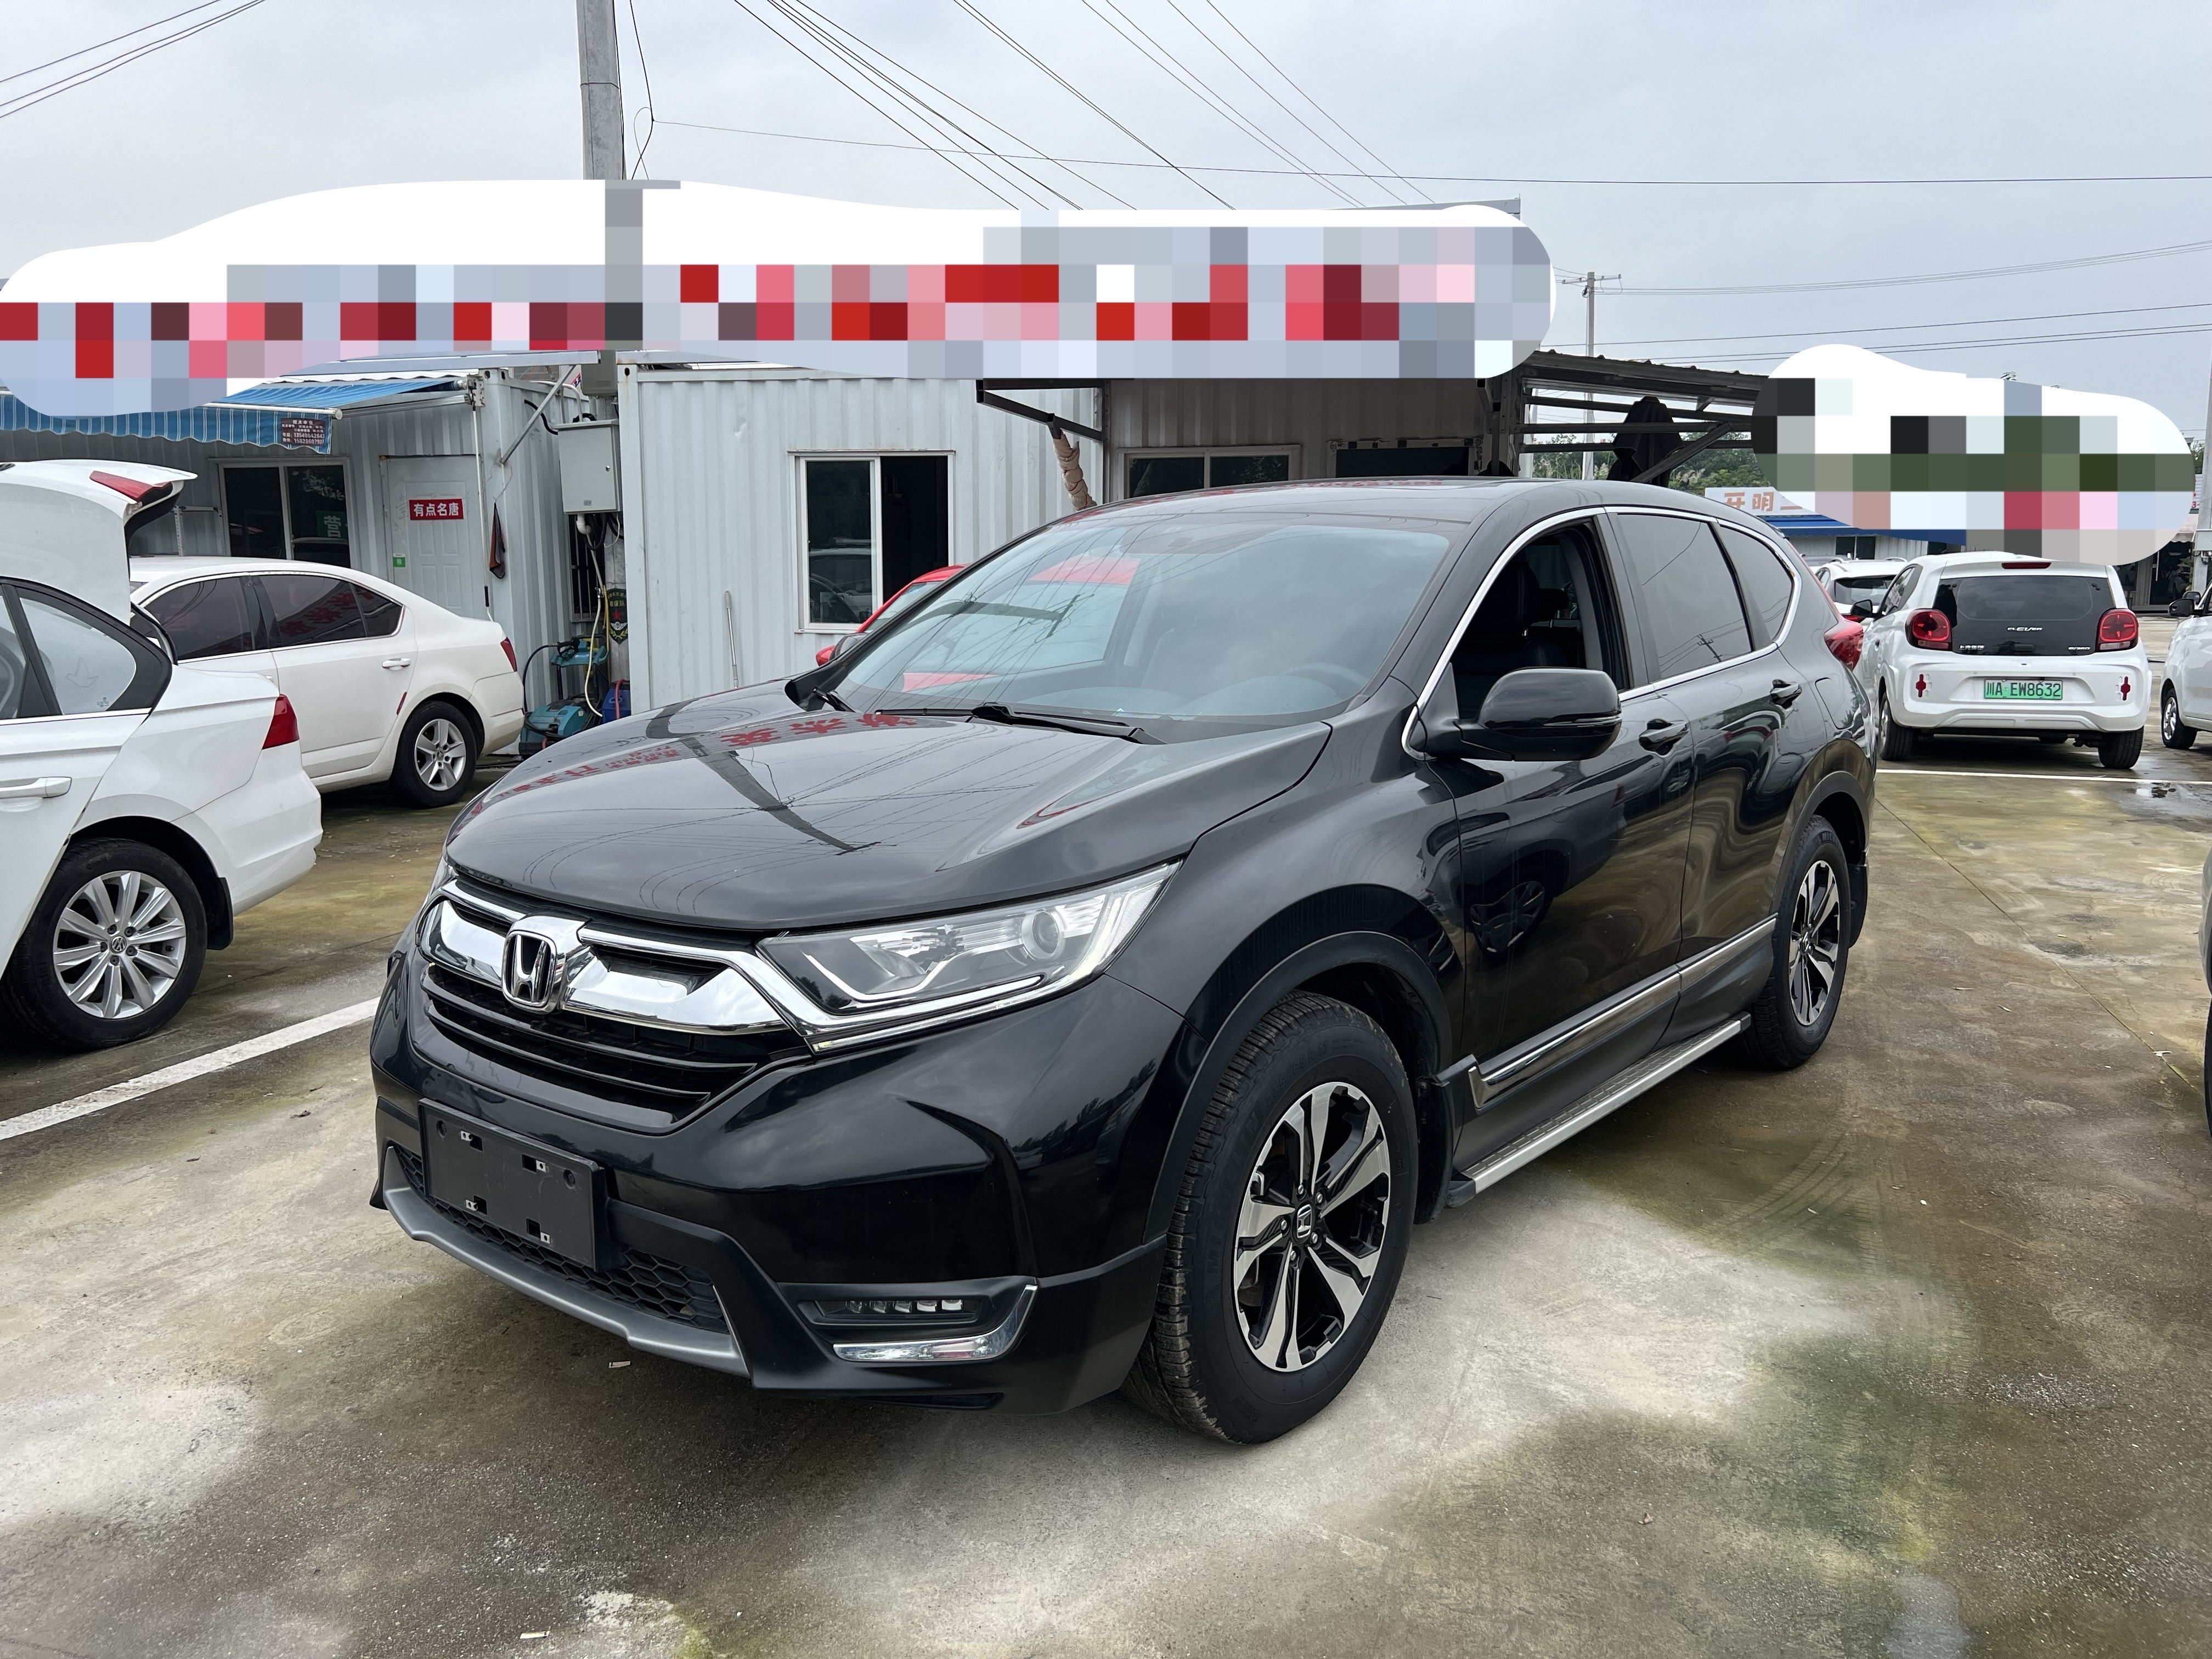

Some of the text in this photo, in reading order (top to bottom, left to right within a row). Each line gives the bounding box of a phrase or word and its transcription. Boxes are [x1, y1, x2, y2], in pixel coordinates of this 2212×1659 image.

[414, 503, 459, 517] 有点名唐
[2010, 682, 2061, 697] EW8632
